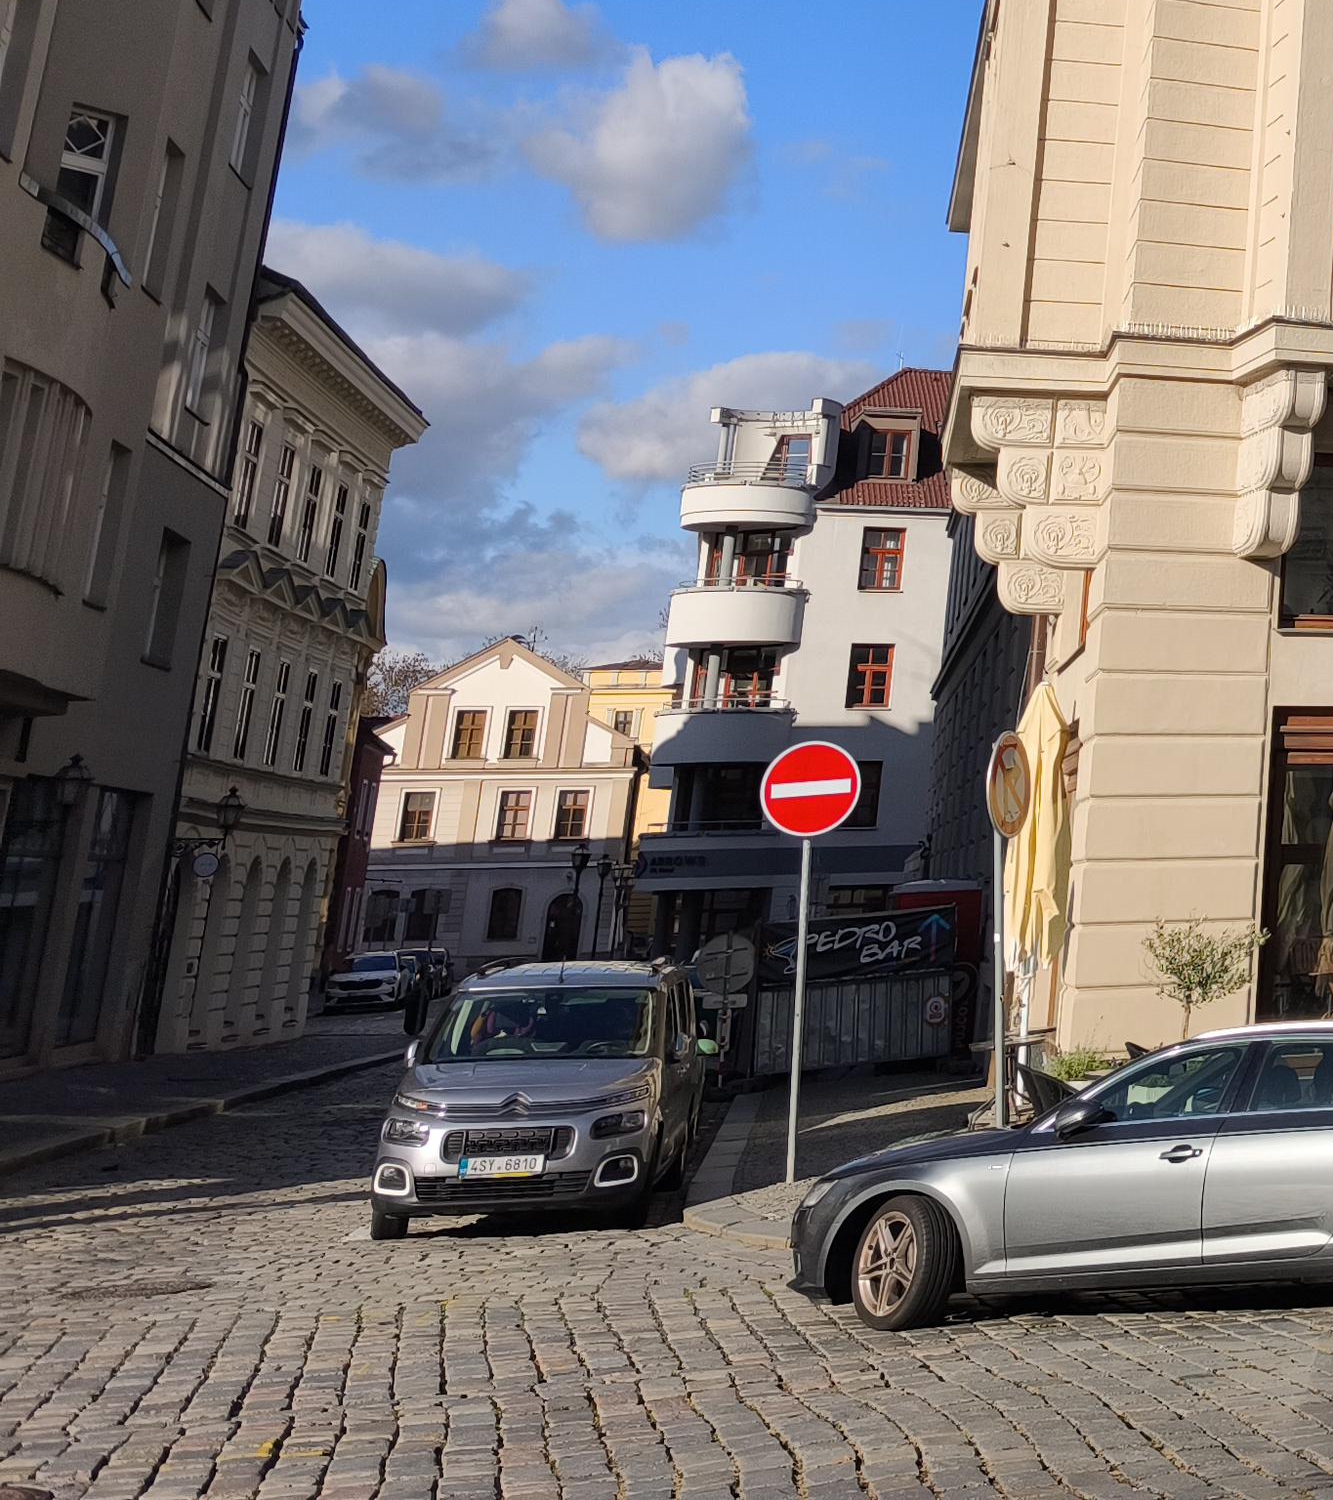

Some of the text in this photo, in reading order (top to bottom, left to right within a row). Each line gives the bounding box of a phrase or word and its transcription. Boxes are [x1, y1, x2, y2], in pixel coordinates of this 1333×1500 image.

[860, 936, 922, 963] BAR
[471, 1157, 537, 1172] 4SY 6810
